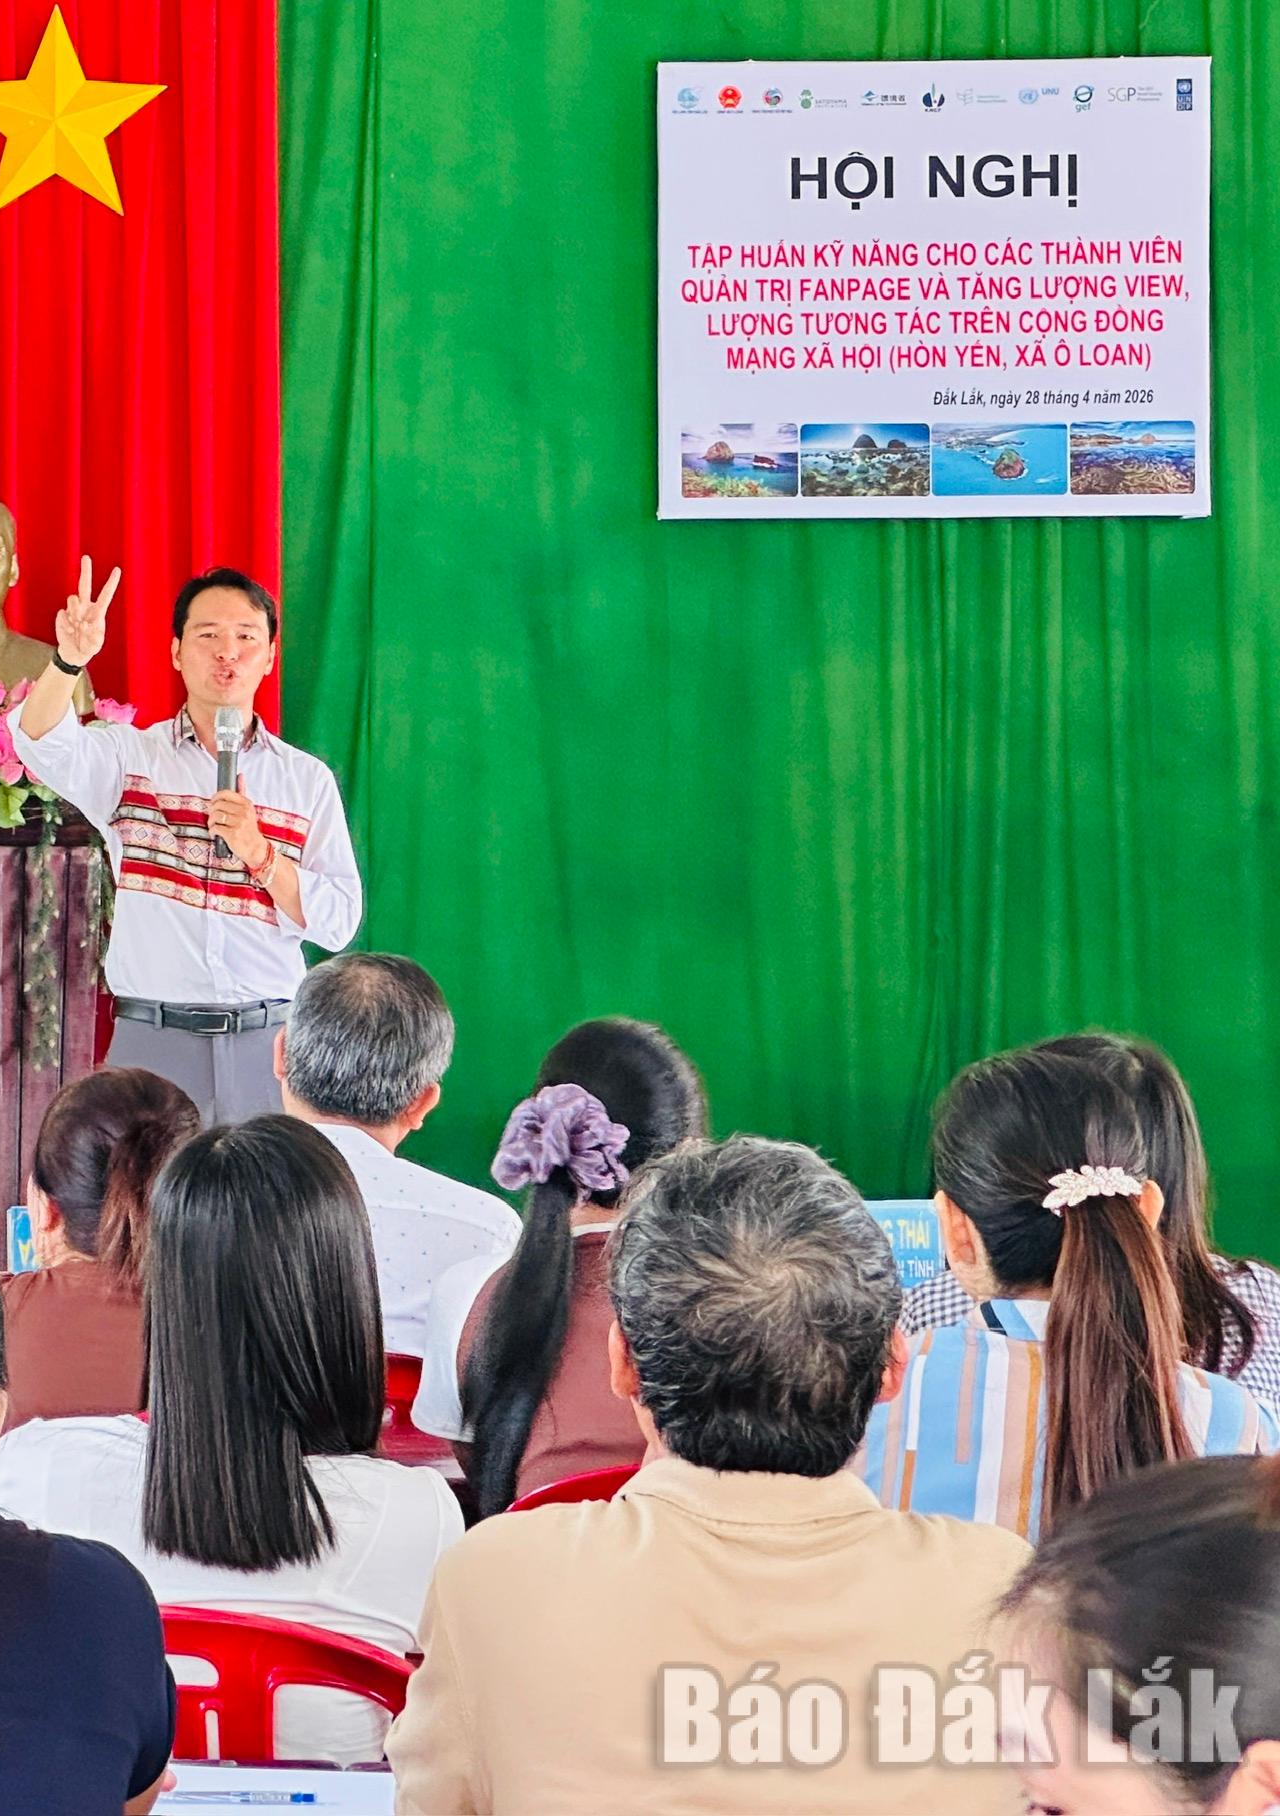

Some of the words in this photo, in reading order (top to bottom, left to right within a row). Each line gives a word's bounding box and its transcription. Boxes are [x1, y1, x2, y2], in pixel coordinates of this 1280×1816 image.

[1041, 87, 1060, 95] UNU
[1075, 102, 1092, 113] gef
[1107, 87, 1137, 102] SGP
[791, 152, 893, 210] HỘI
[929, 154, 1077, 207] NGHỊ
[688, 243, 732, 274] TẬP
[741, 240, 805, 268] HUẤN
[814, 240, 844, 267] KỸ
[853, 240, 918, 266] NĂNG
[927, 243, 976, 266] CHO
[985, 237, 1032, 265] CÁC
[1041, 237, 1120, 264] THÀNH
[1129, 236, 1181, 263] VIÊN
[682, 275, 747, 303] QUẢN
[755, 279, 791, 307] TRỊ
[800, 278, 910, 301] FANPAGE
[918, 272, 949, 300] VÀ
[957, 273, 1021, 299] TĂNG
[1031, 275, 1116, 304] LƯỢNG
[1125, 275, 1189, 301] VIEW,
[708, 313, 793, 341] LƯỢNG
[801, 312, 887, 335] TƯƠNG
[895, 307, 940, 334] TÁC
[949, 306, 1010, 333] TRÊN
[1019, 308, 1087, 338] CỘNG
[1094, 305, 1163, 332] ĐỒNG
[727, 347, 795, 374] MẠNG
[803, 342, 834, 368] XÃ
[842, 345, 880, 373] HỘI
[890, 341, 946, 373] (HÒN
[955, 340, 1006, 370] YẾN,
[1016, 340, 1046, 366] XÃ
[1054, 339, 1070, 366] Ô
[1080, 344, 1151, 370] LOAN)
[934, 388, 957, 405] Đắk
[961, 388, 986, 407] Lắk,
[990, 391, 1021, 408] ngày
[1026, 390, 1039, 404] 28
[1044, 391, 1079, 408] tháng
[1083, 390, 1089, 403] 4
[1094, 390, 1120, 403] năm
[1125, 390, 1153, 403] 2026
